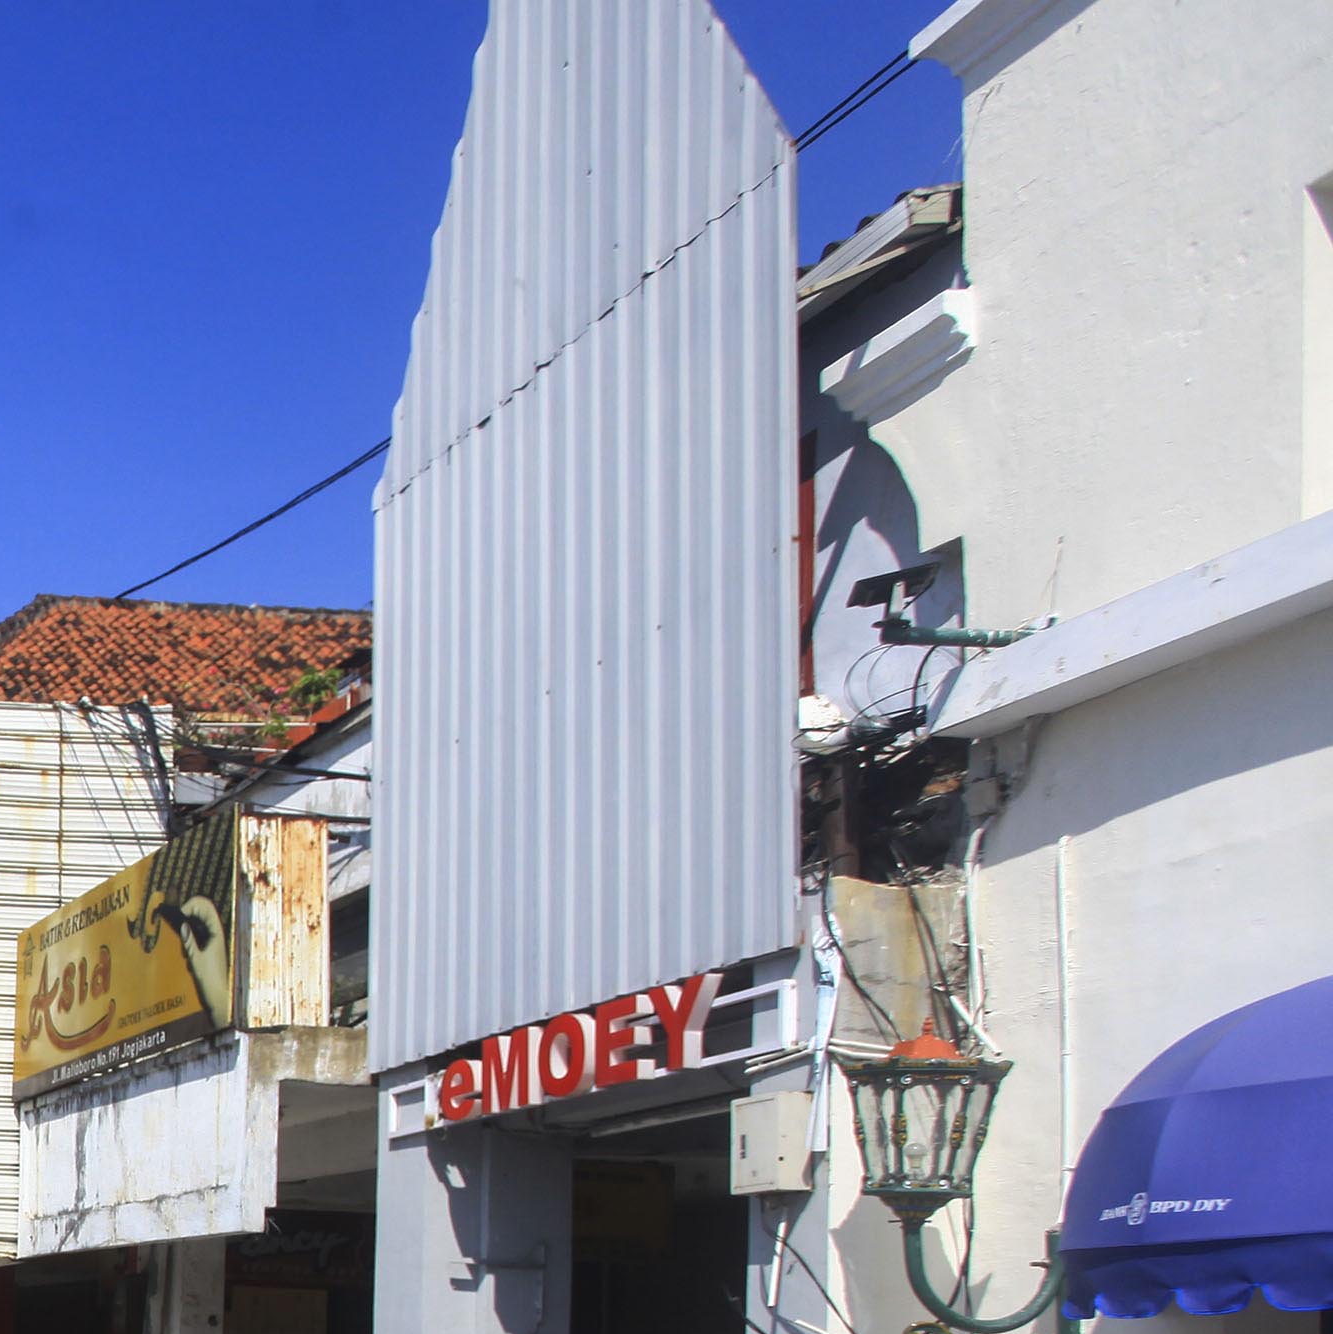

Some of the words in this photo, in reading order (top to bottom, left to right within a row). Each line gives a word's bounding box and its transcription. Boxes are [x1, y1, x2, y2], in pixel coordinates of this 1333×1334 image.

[20, 944, 116, 1052] Asia
[60, 1057, 96, 1079] Malioboro
[120, 1030, 166, 1059] Jogjakarta
[437, 972, 724, 1123] eMOEY
[1149, 1200, 1191, 1214] BPD
[1192, 1198, 1233, 1212] DIY
